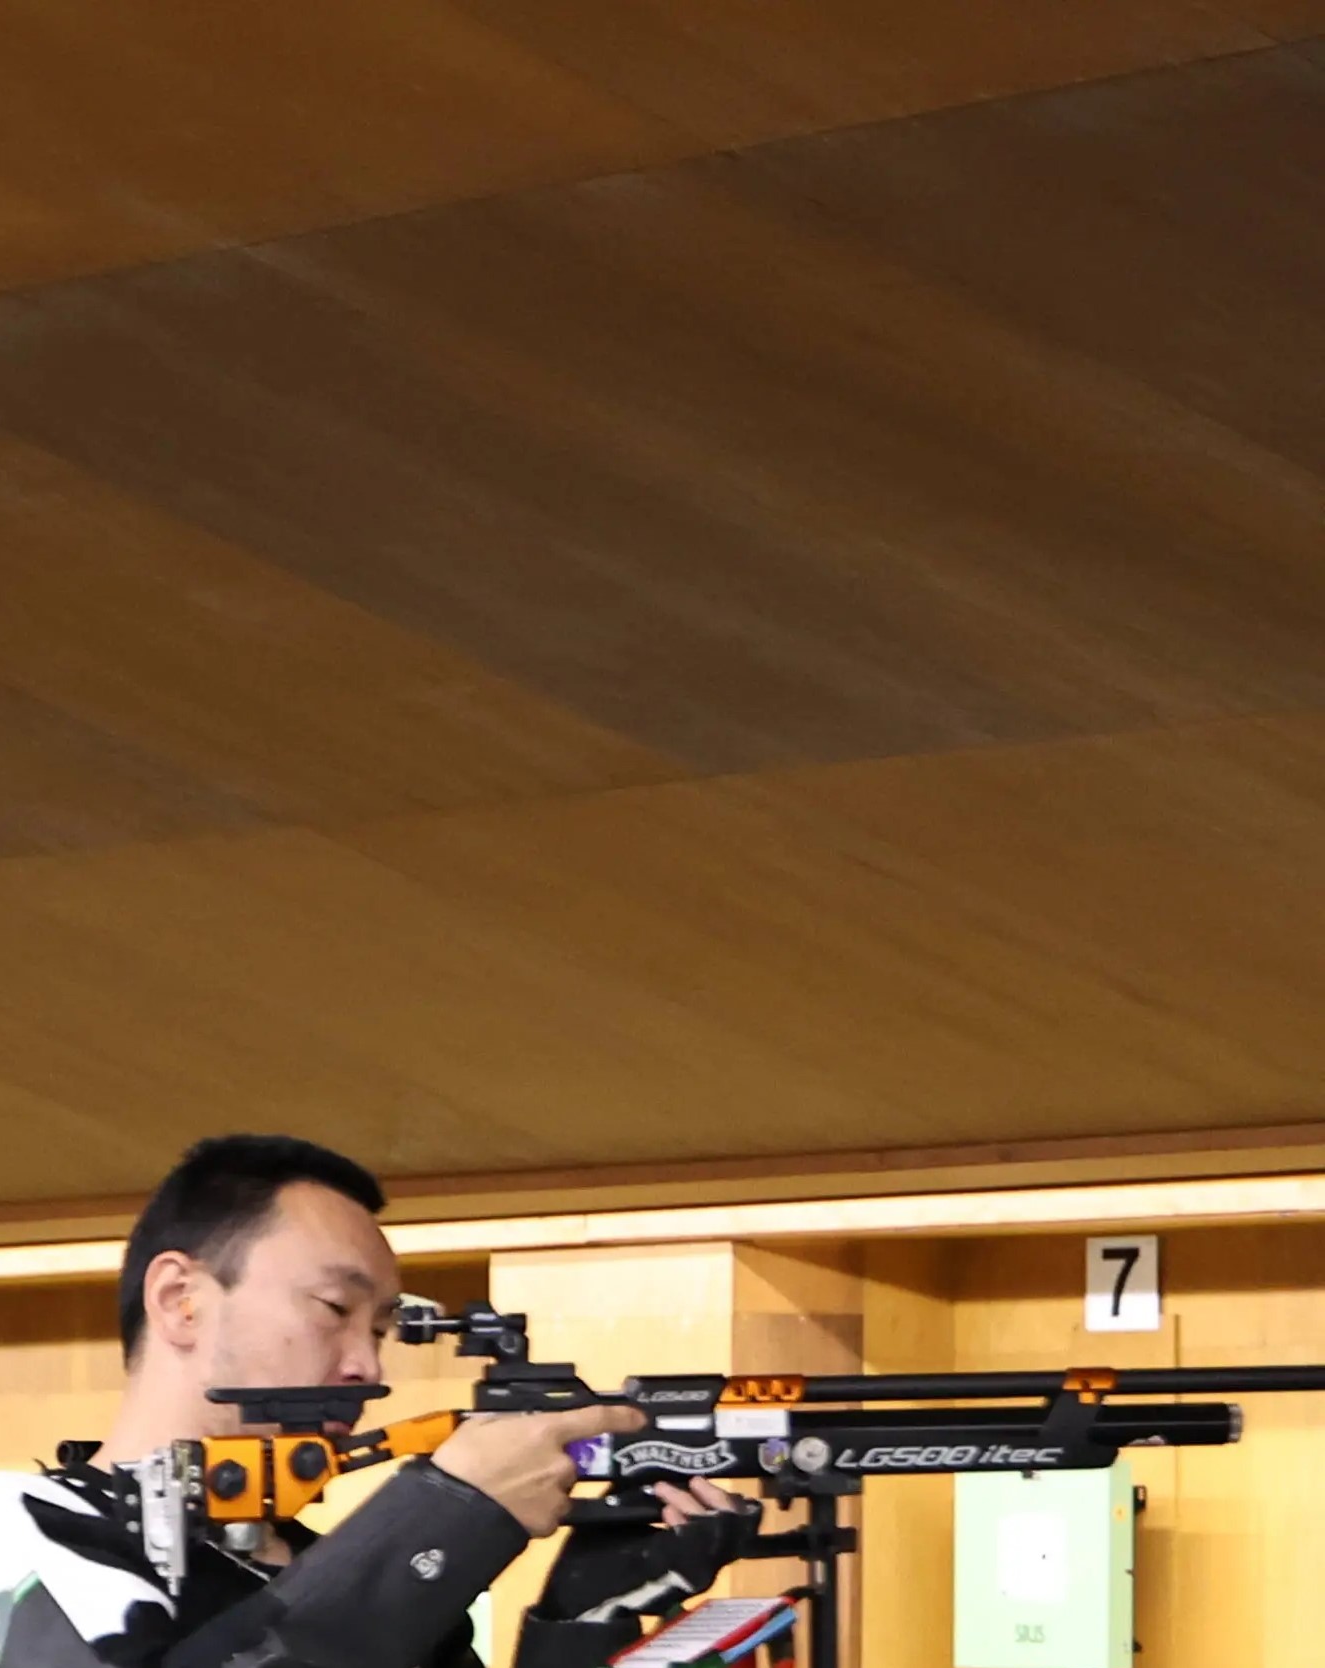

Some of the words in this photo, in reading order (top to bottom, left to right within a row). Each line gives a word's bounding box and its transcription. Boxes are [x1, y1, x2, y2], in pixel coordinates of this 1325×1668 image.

[1102, 1247, 1140, 1317] 7
[633, 1443, 718, 1468] WALTHER
[834, 1445, 979, 1468] LG500
[977, 1444, 1064, 1464] itec
